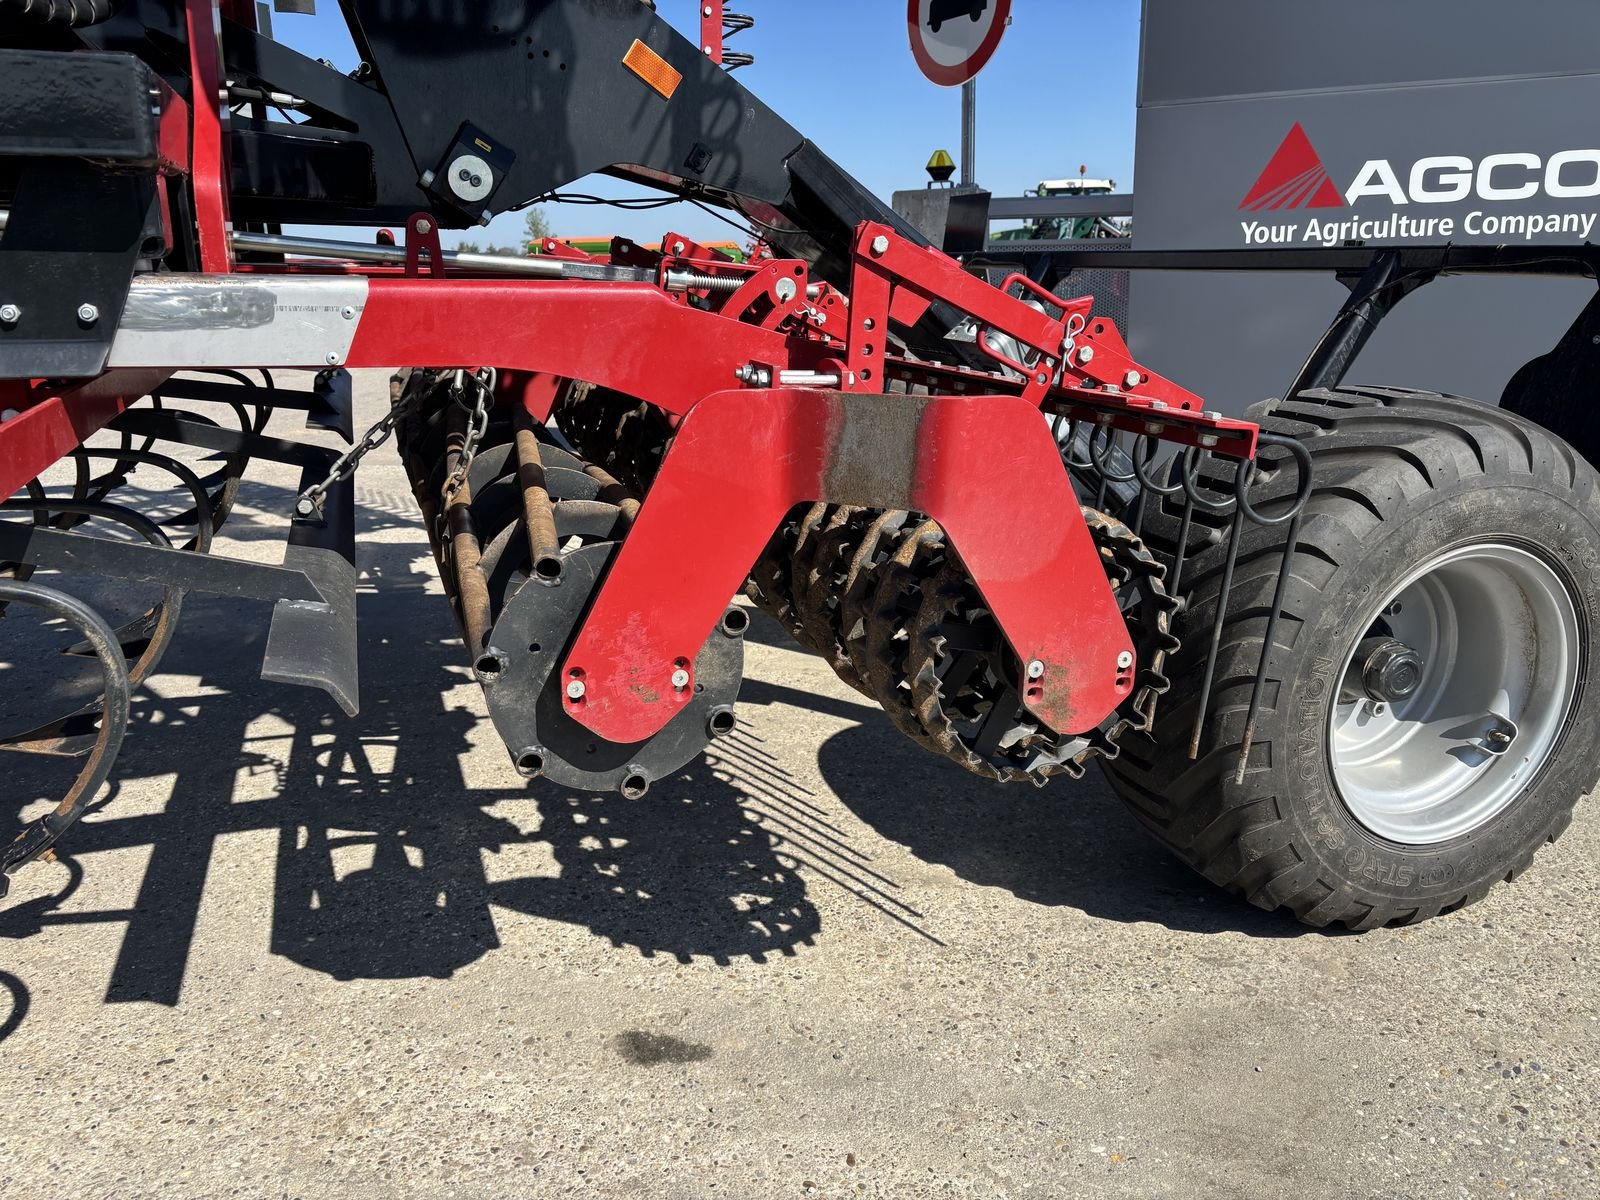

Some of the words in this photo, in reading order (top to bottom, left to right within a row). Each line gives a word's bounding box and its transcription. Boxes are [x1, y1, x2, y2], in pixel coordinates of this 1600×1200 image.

[1344, 148, 1600, 206] AGCO
[1241, 221, 1298, 244] Your
[1303, 213, 1454, 247] Agriculture
[1463, 210, 1598, 246] Company
[1297, 655, 1333, 816] FLOTATION
